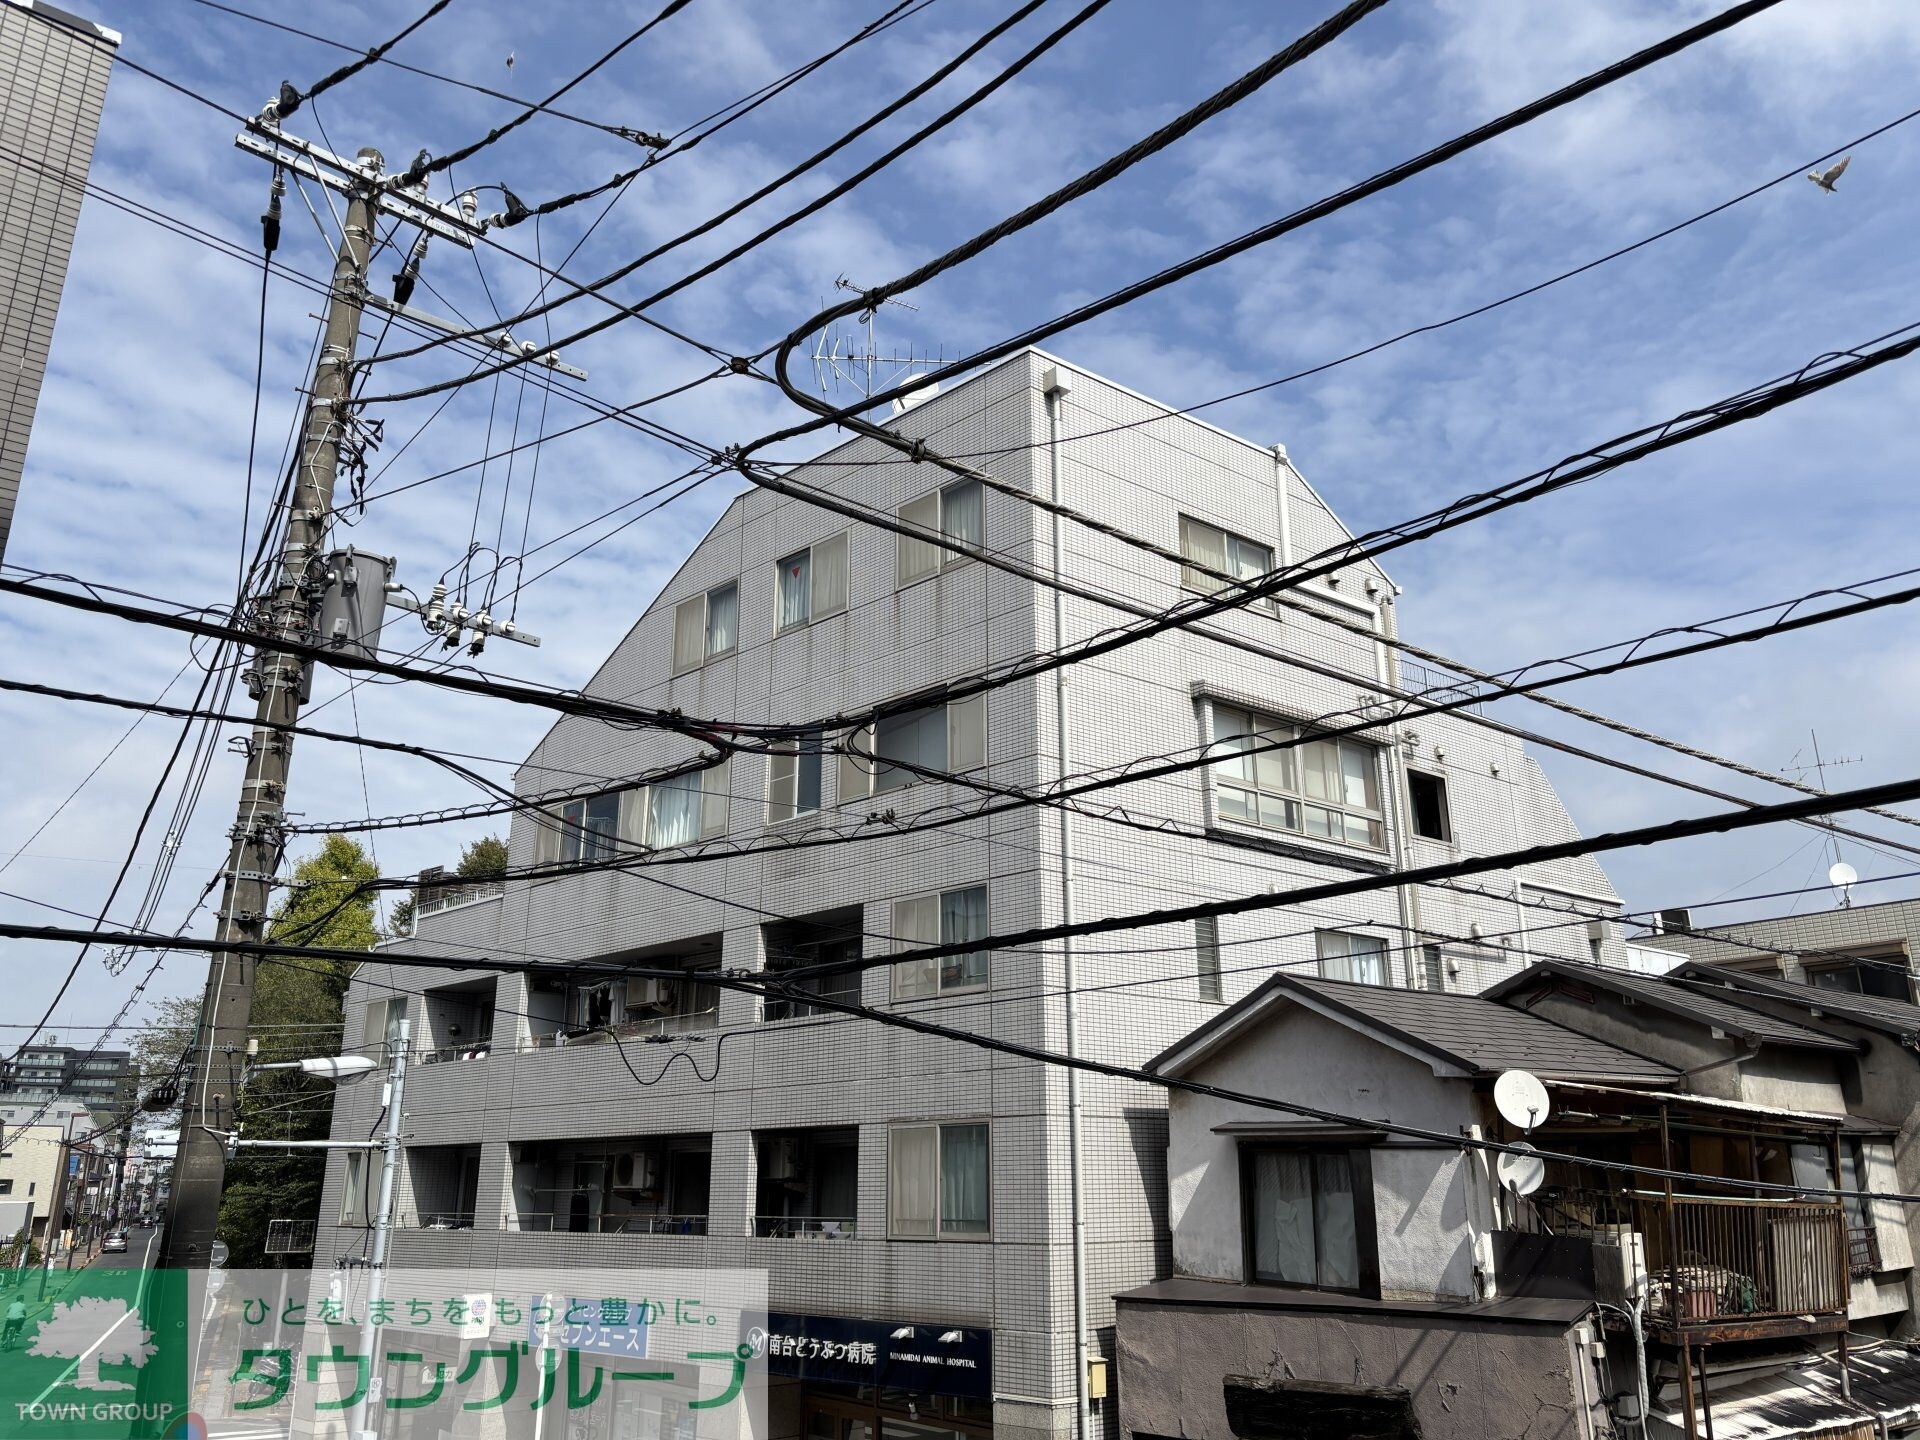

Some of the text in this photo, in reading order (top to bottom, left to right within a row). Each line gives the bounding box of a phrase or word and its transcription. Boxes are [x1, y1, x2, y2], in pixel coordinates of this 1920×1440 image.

[768, 1333, 877, 1365] 南台どうぶつ病院
[889, 1351, 977, 1370] MINAMIDAI ANIMAL HOSPITAL
